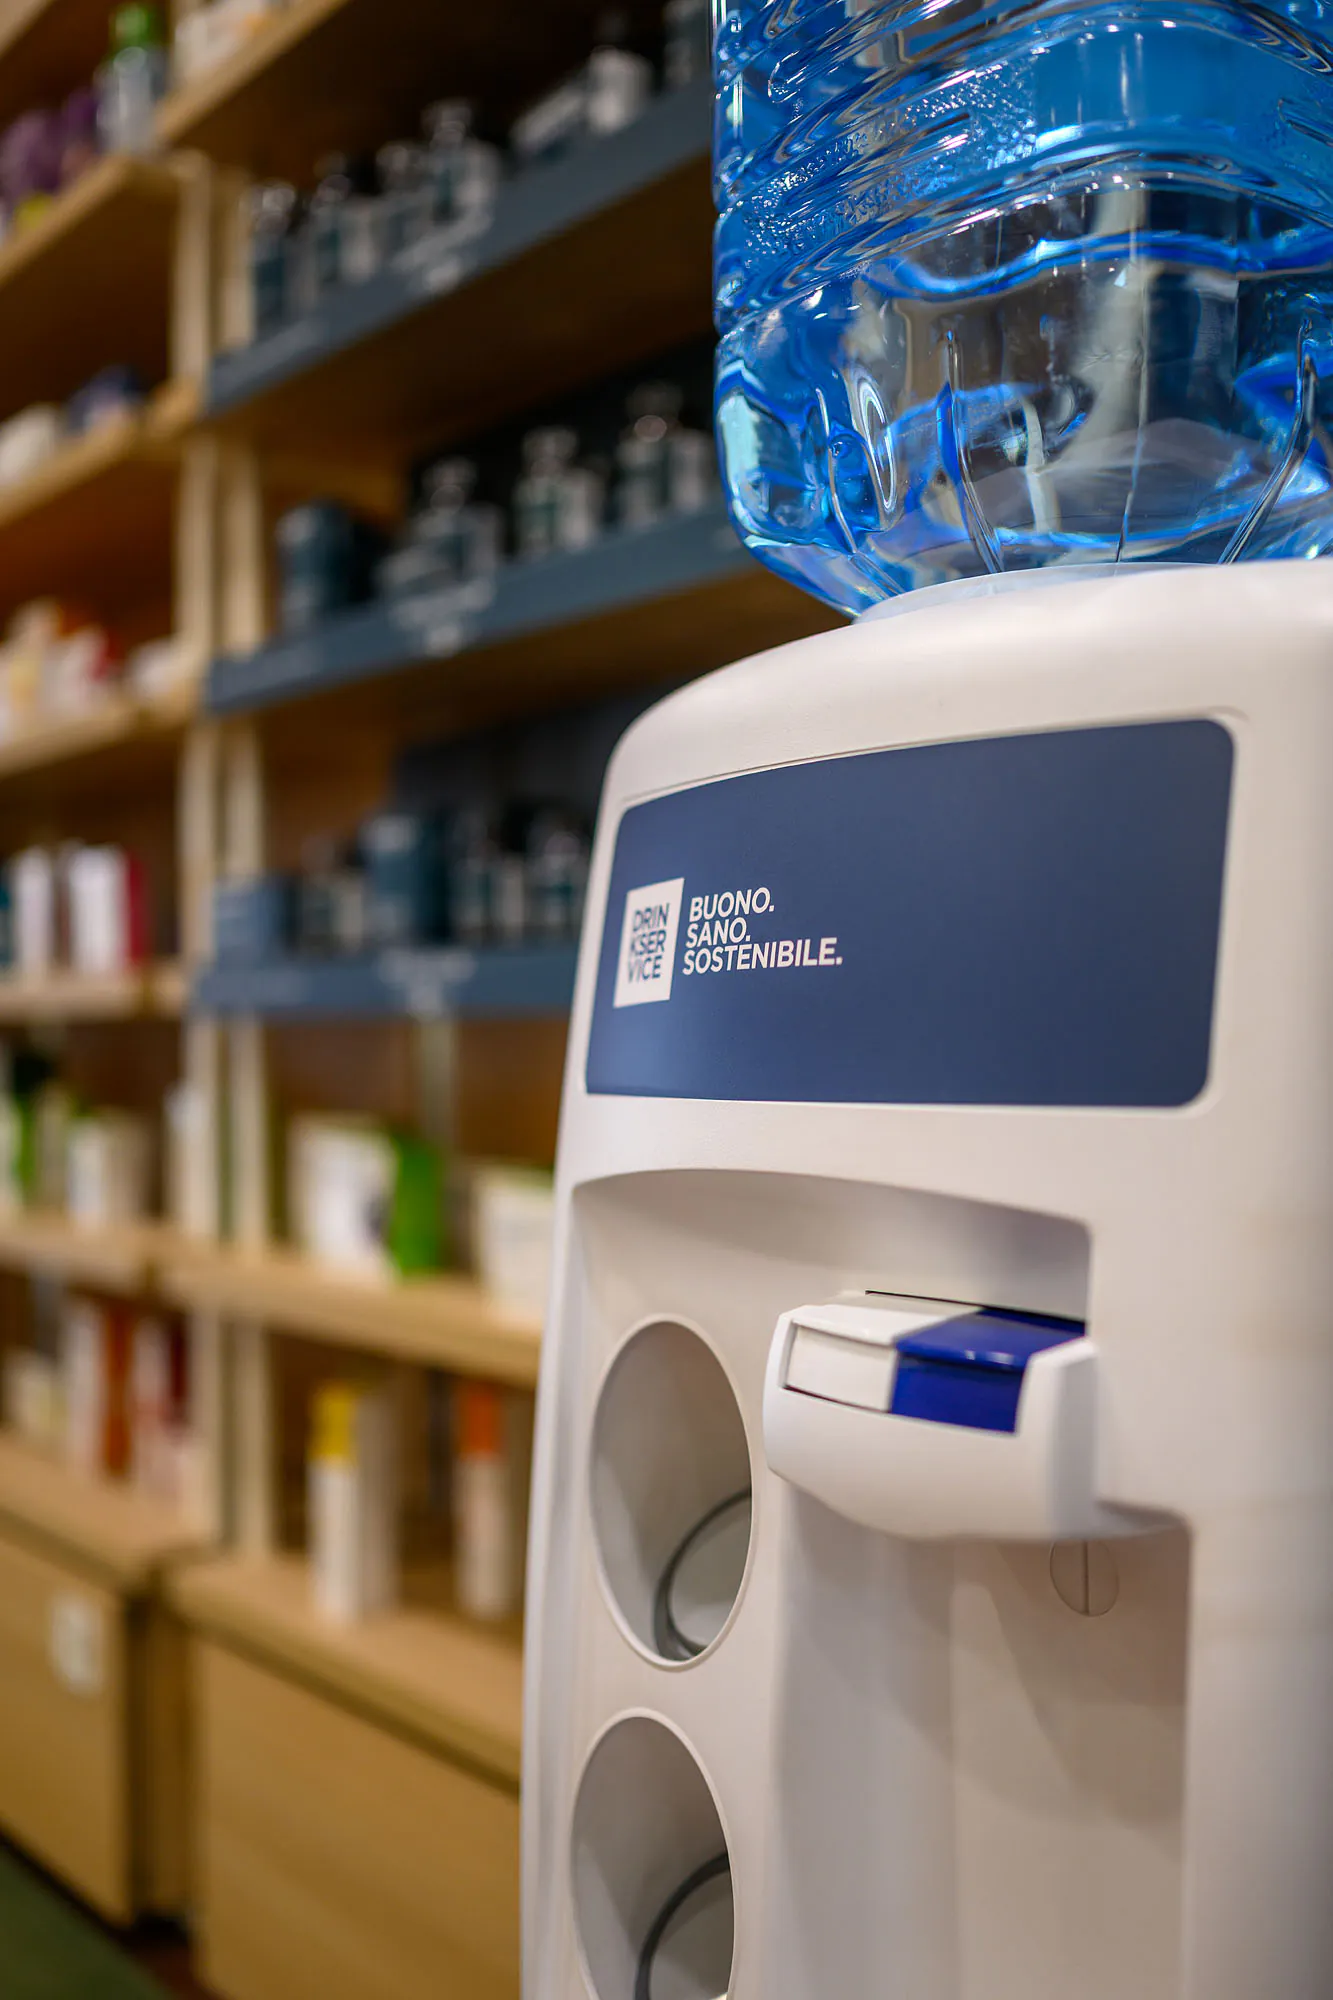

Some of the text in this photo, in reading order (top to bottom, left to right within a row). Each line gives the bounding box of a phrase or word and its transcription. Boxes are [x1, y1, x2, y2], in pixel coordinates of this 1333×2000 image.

[633, 902, 670, 933] DRIN
[689, 887, 775, 922] BUONO.
[630, 929, 667, 957] KSER
[685, 917, 751, 949] SANO.
[627, 955, 662, 983] VICE
[682, 937, 843, 975] SOSTENIBILE.
